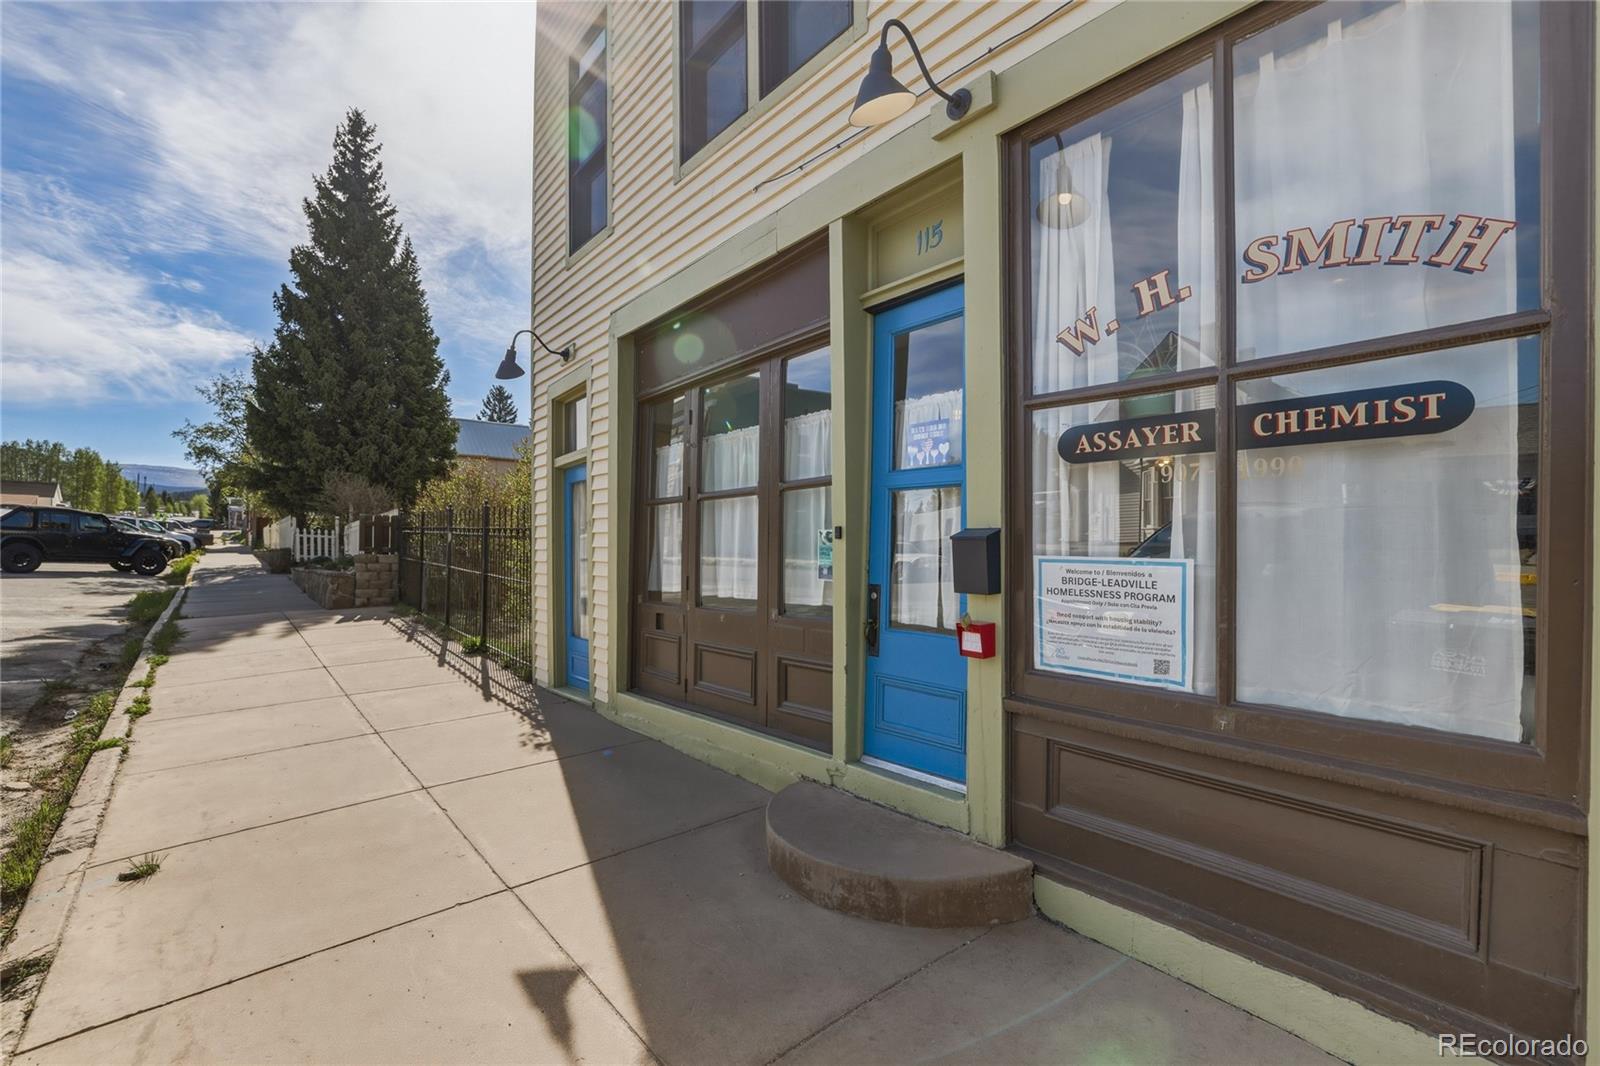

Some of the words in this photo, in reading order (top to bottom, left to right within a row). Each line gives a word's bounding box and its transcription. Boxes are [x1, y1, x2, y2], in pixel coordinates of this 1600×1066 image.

[915, 218, 944, 256] 115
[1055, 305, 1120, 357] W.
[1129, 269, 1192, 320] H.
[1241, 213, 1518, 284] SMITH
[1075, 421, 1202, 454] ASSAYER
[1252, 392, 1446, 438] CHEMIST
[1149, 462, 1200, 484] 1907
[1061, 576, 1158, 590] BRIDGE-LEADVILLE
[1106, 570, 1146, 578] Bienvenidos
[1046, 587, 1122, 600] HOMELESSNESS
[1123, 591, 1176, 604] PROGRAM
[1133, 618, 1162, 628] stability?
